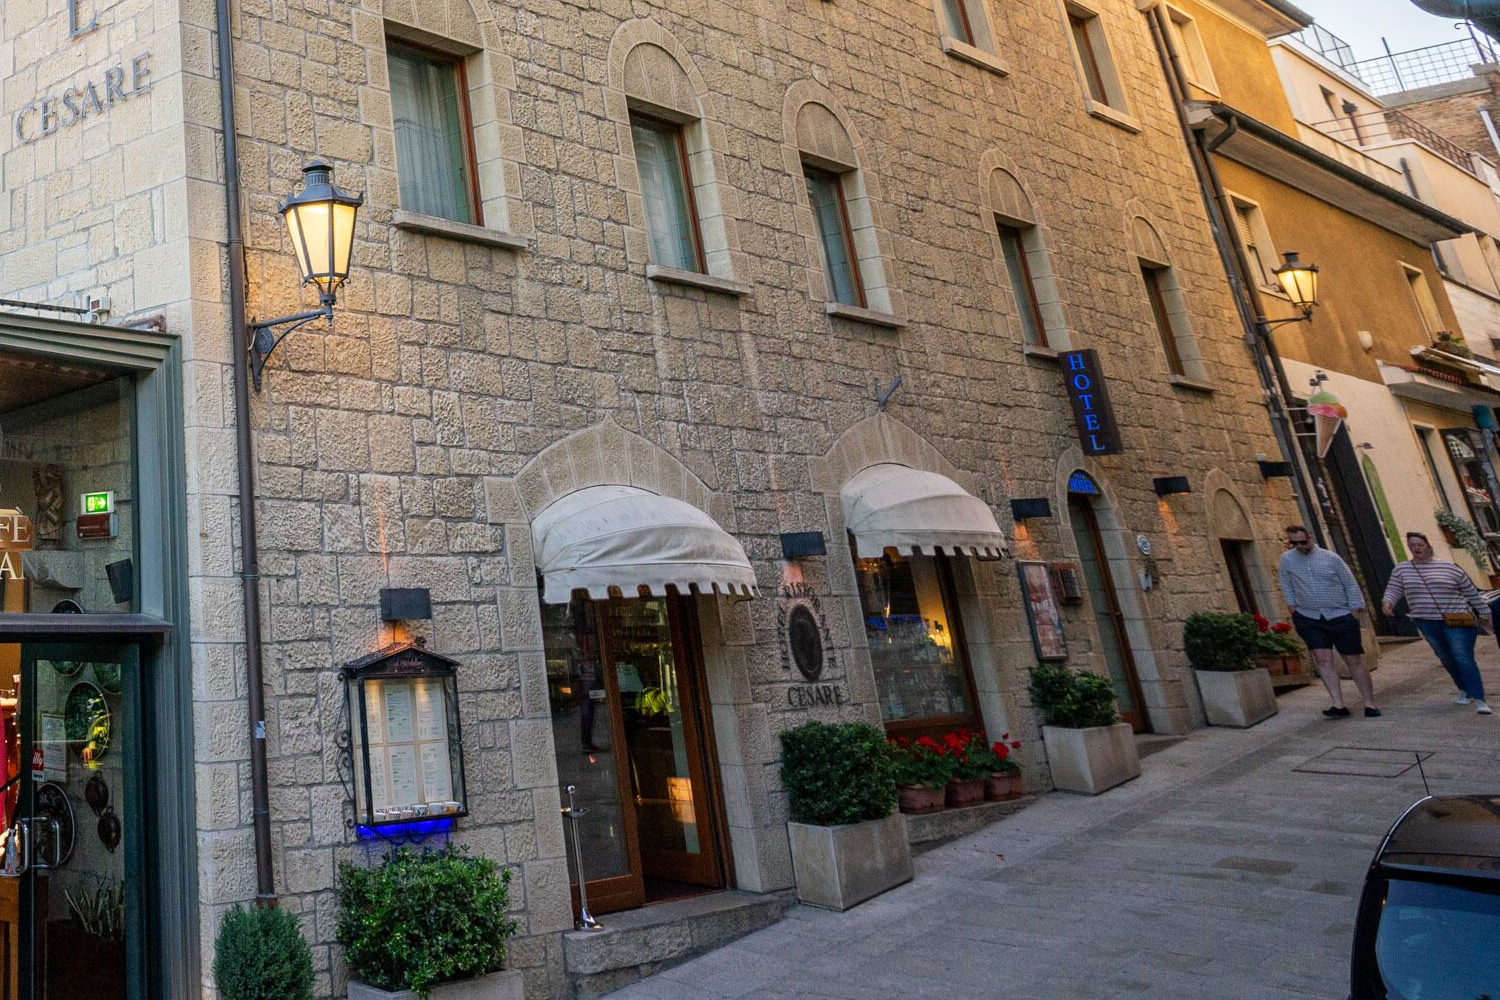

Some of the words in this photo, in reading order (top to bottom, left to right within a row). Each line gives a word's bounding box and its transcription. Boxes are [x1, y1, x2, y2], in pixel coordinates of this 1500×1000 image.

[14, 50, 153, 145] CESARE
[1068, 351, 1106, 451] HOTEL
[787, 685, 844, 707] CESARE
